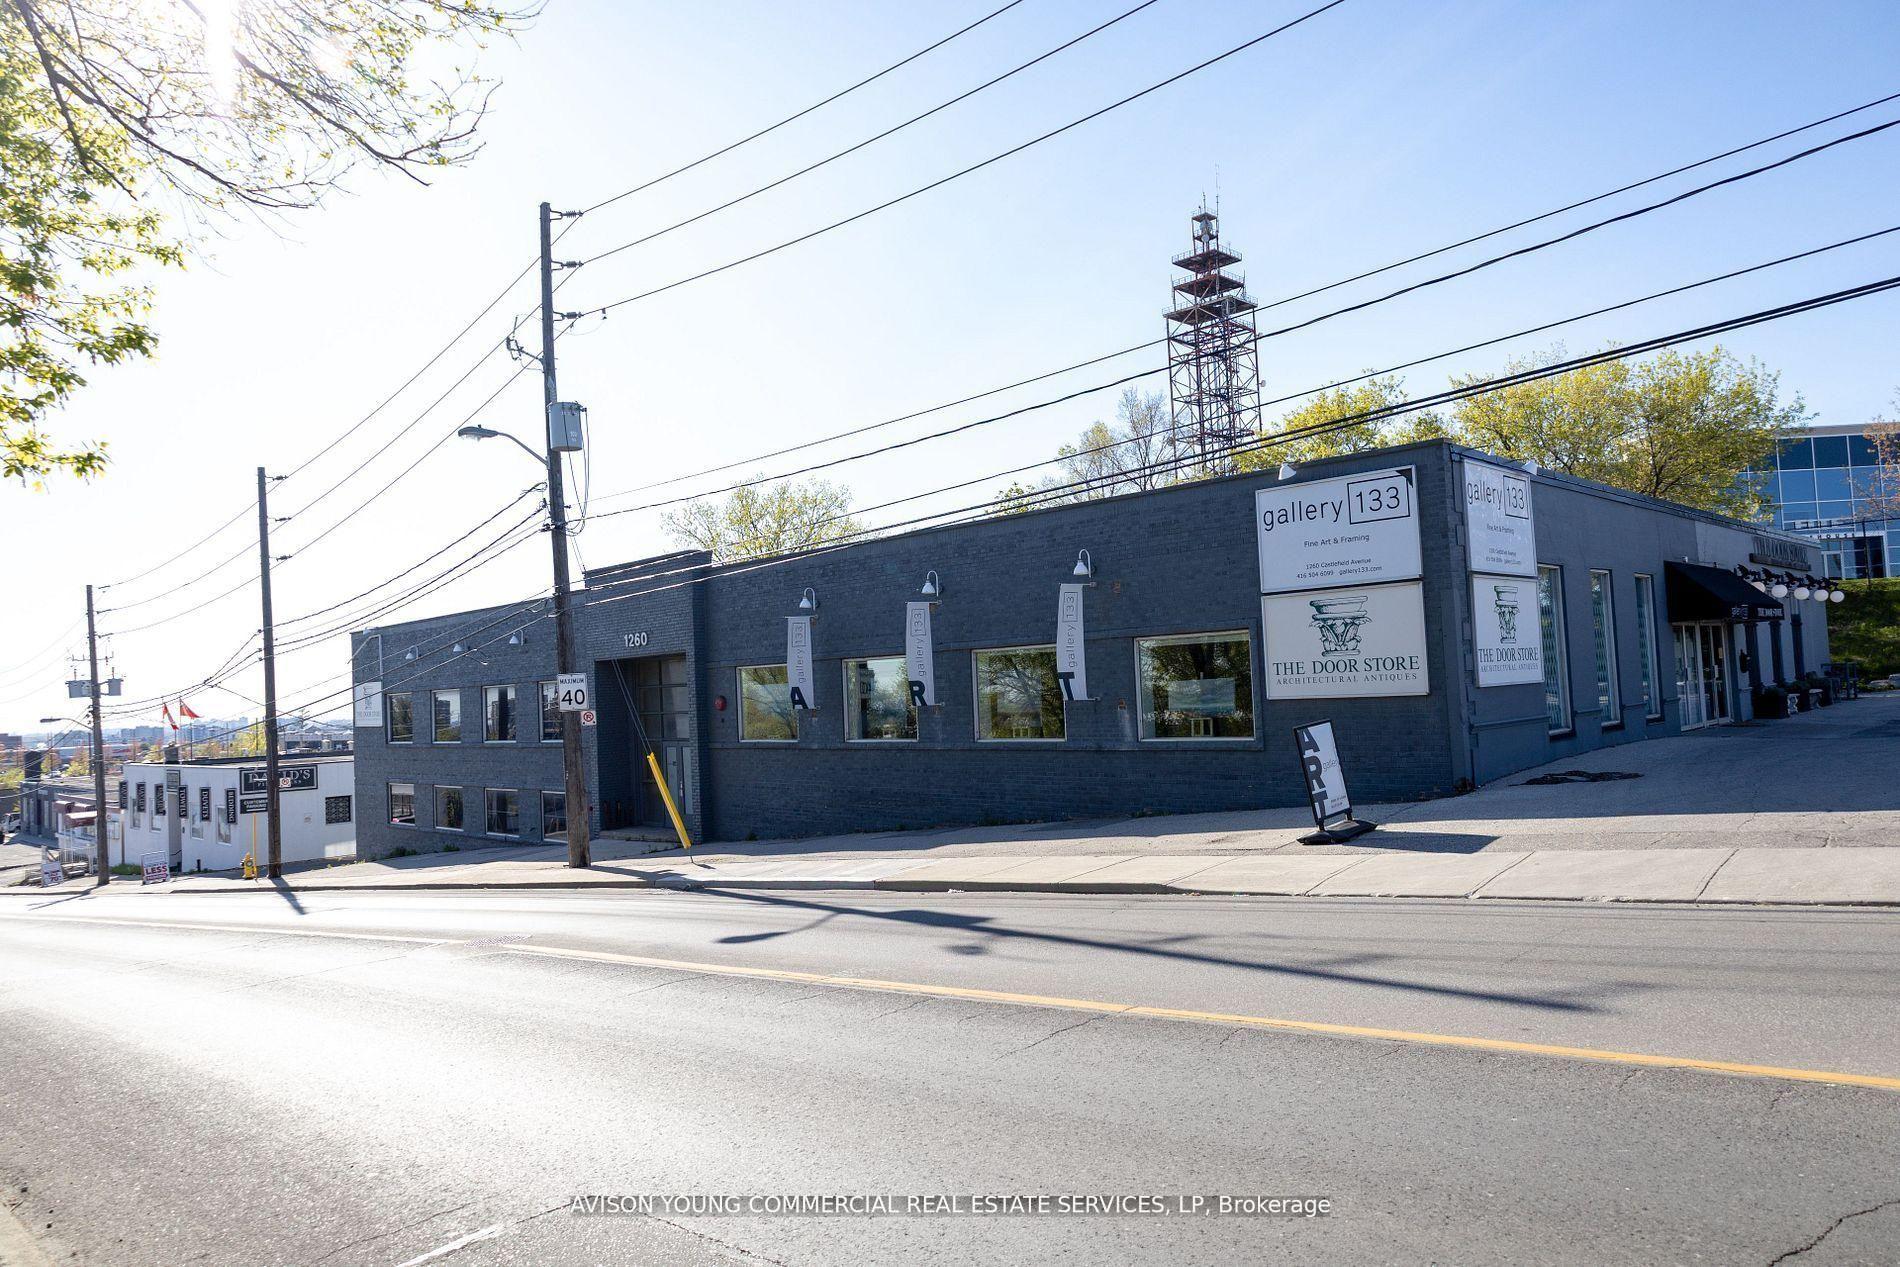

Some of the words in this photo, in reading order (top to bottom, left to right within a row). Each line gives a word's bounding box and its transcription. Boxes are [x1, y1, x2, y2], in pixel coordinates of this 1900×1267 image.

[1467, 480, 1502, 510] gallery
[1506, 486, 1525, 510] 133
[1263, 500, 1343, 531] gallery
[1355, 486, 1400, 513] 133
[1304, 540, 1319, 548] Fine
[1320, 538, 1331, 546] Art
[1341, 534, 1370, 544] Framing
[1066, 596, 1075, 619] 133
[914, 612, 922, 633] 133
[624, 632, 648, 647] 1260
[794, 625, 804, 645] 133
[915, 637, 927, 677] gallery
[1066, 625, 1078, 668] gallery
[1478, 648, 1494, 663] THE
[1495, 647, 1517, 662] DOOR
[1517, 647, 1539, 661] STORE
[1273, 661, 1305, 676] THE
[1312, 659, 1360, 675] DOOR
[1364, 655, 1420, 672] STORE
[1276, 675, 1359, 685] ARCHITECTURAL
[1363, 673, 1418, 683] ANTIQUES
[561, 689, 586, 706] 40
[791, 686, 809, 710] A
[907, 680, 928, 707] R
[248, 769, 311, 784] DAID'S
[1300, 727, 1329, 819] ART
[179, 789, 187, 816] TOWELS
[145, 865, 168, 875] LESS
